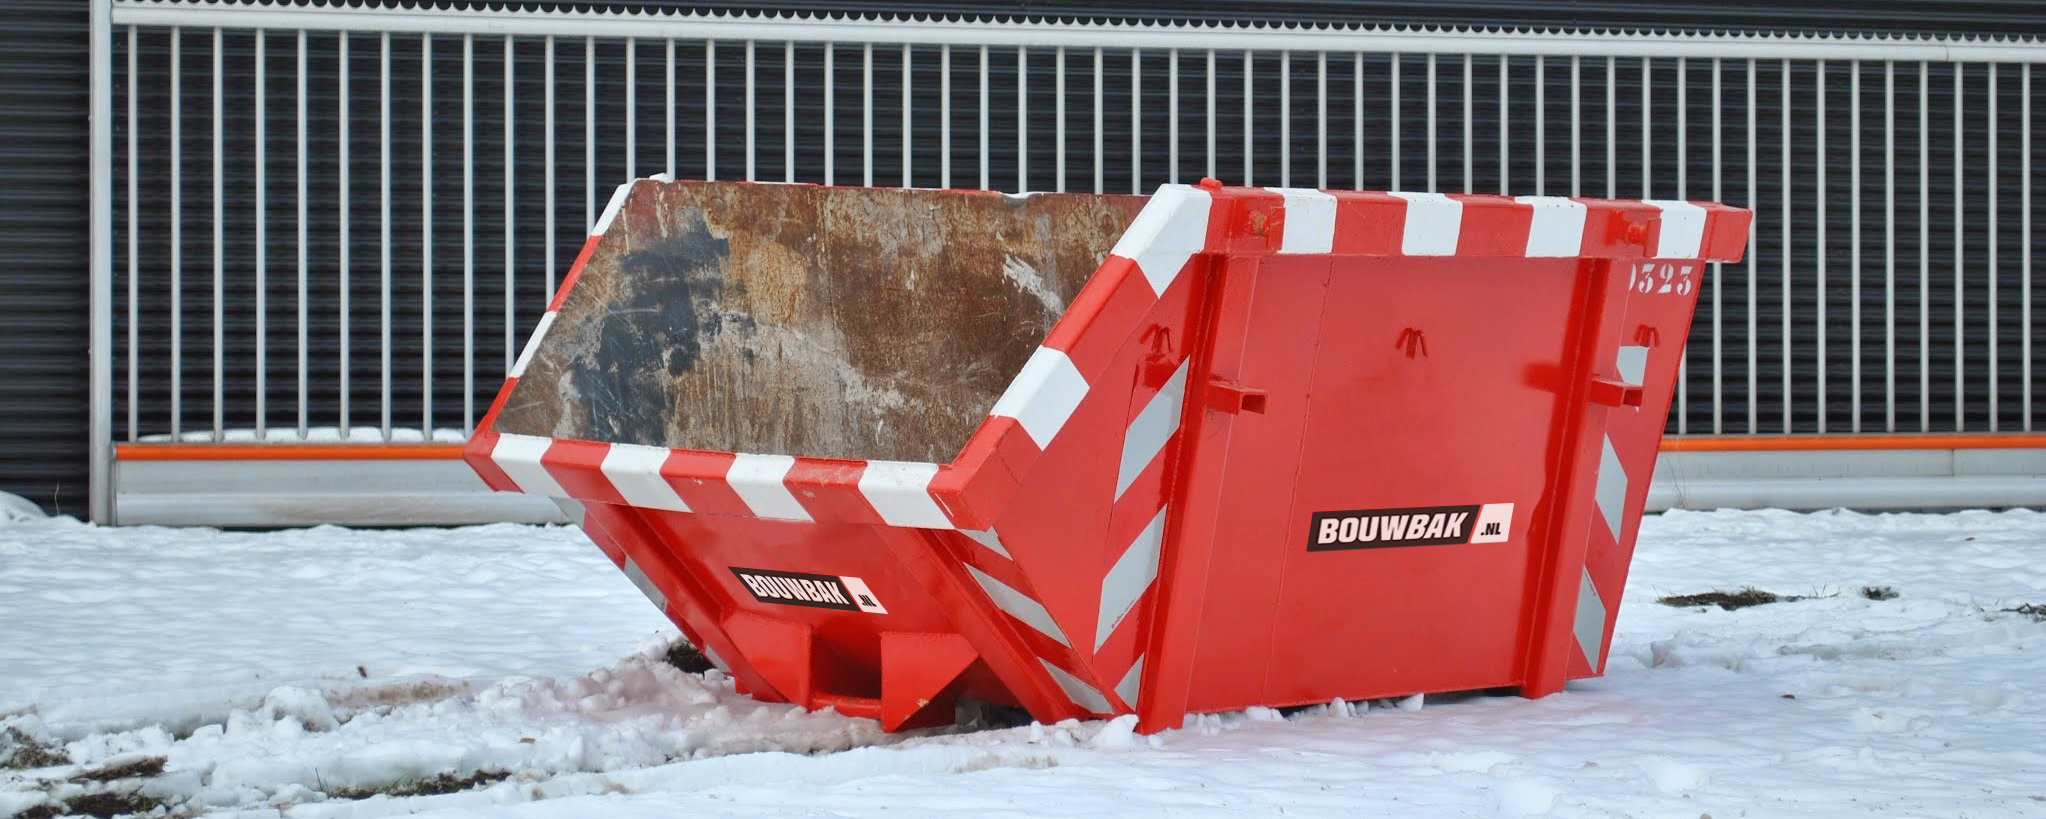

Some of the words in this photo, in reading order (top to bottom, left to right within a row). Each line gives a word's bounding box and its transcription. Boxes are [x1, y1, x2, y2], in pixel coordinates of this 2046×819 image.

[1317, 511, 1470, 545] BOUWBAK
[1480, 522, 1501, 536] .NL
[739, 573, 850, 605] BOUWBAK
[858, 593, 878, 608] .NL
